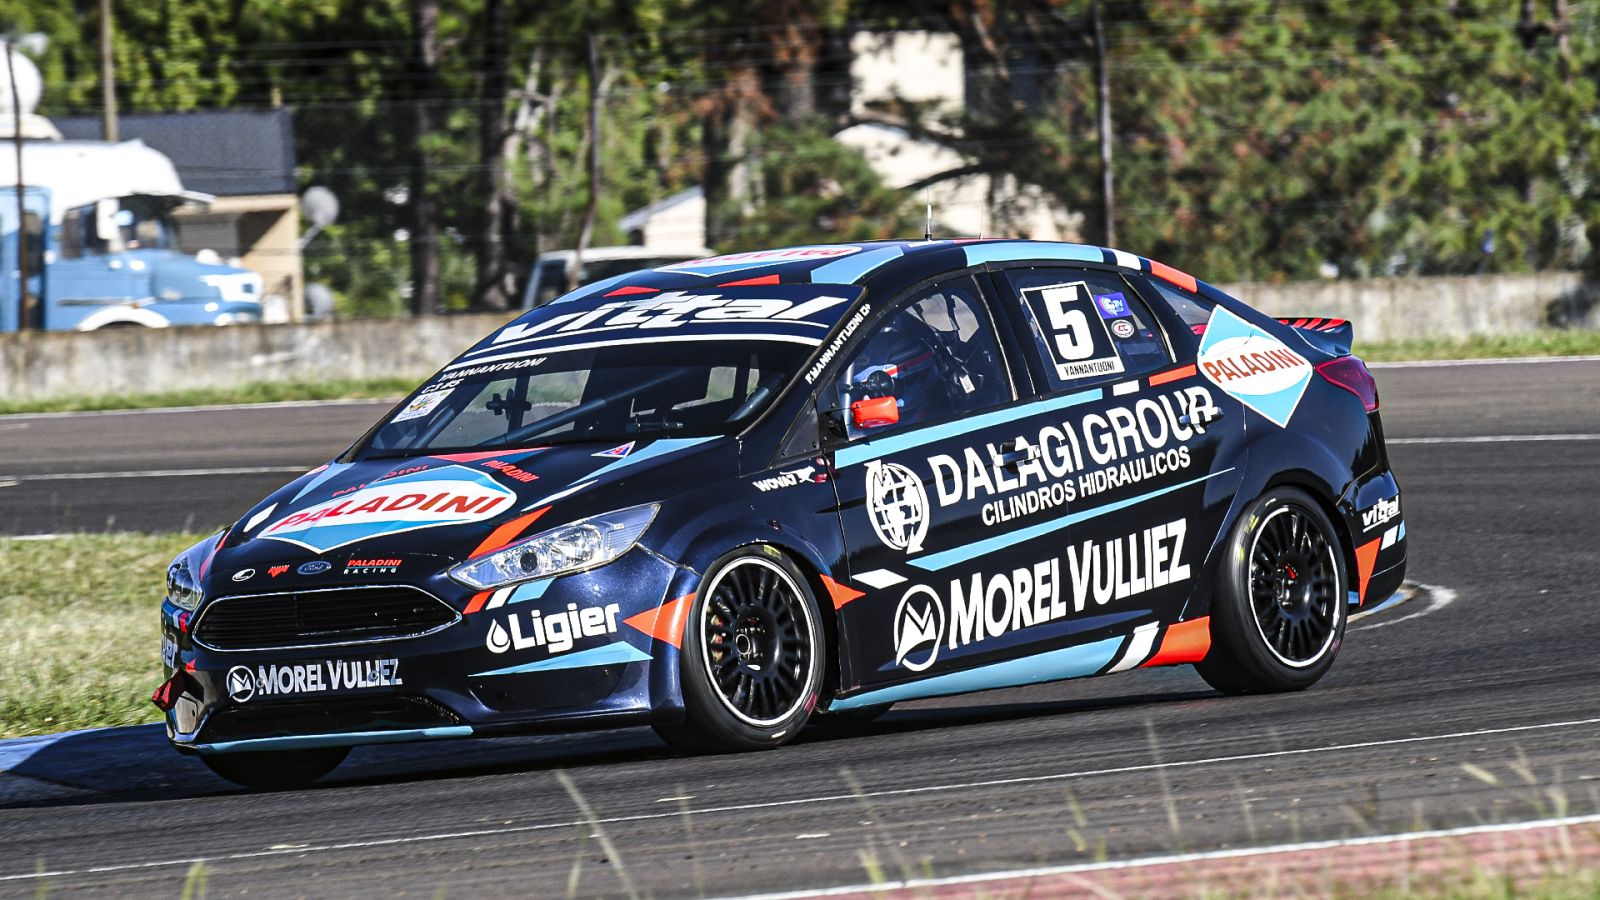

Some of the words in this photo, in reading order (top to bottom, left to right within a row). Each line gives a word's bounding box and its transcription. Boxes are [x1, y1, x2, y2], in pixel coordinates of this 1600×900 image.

[1041, 286, 1095, 361] 5
[1063, 360, 1115, 377] YANNANTUONI
[1202, 348, 1304, 383] PALADINI
[927, 421, 1084, 507] DALAGI
[1082, 386, 1214, 464] GROUP
[981, 480, 1076, 526] CILINDROS
[1078, 445, 1192, 499] HIDRAULICOS
[268, 495, 507, 531] PALADINI
[343, 567, 398, 575] RACING
[347, 559, 402, 567] PALADINI
[949, 556, 1065, 650] MOREL
[1066, 518, 1191, 612] VULLIEZ
[508, 602, 620, 653] Ligier
[257, 664, 327, 696] MOREL
[326, 658, 403, 690] VULLIEZ
